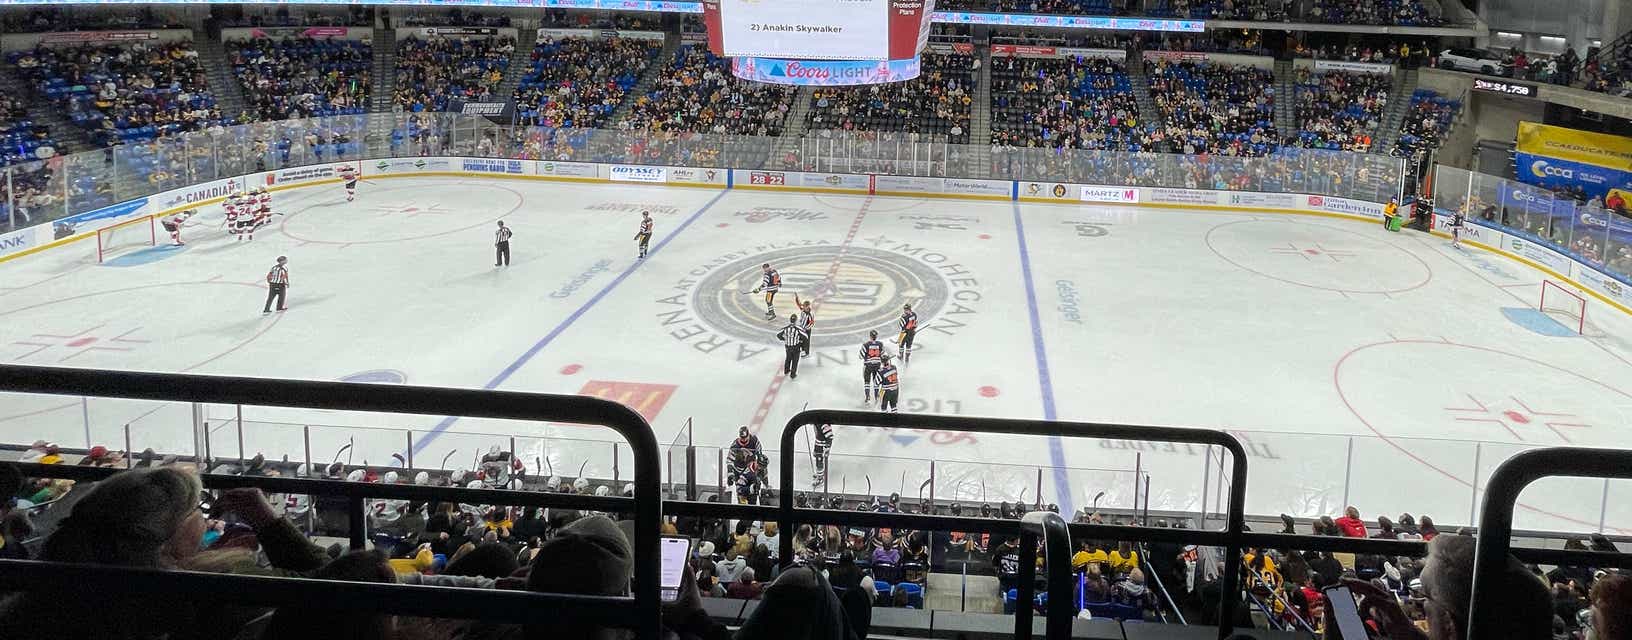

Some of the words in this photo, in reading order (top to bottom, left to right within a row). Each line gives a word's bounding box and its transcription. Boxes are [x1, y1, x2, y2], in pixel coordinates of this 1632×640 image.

[750, 23, 761, 31] 2)
[762, 24, 794, 32] Anakin
[795, 25, 842, 34] Skywalker
[786, 61, 830, 79] Coors
[832, 67, 872, 79] LIGHT
[612, 167, 664, 175] ODYSSEY
[752, 176, 766, 184] 28
[769, 177, 783, 185] 22
[1085, 189, 1120, 198] MARTZ
[894, 242, 983, 337] MOHEGAN
[655, 292, 770, 363] ARENA
